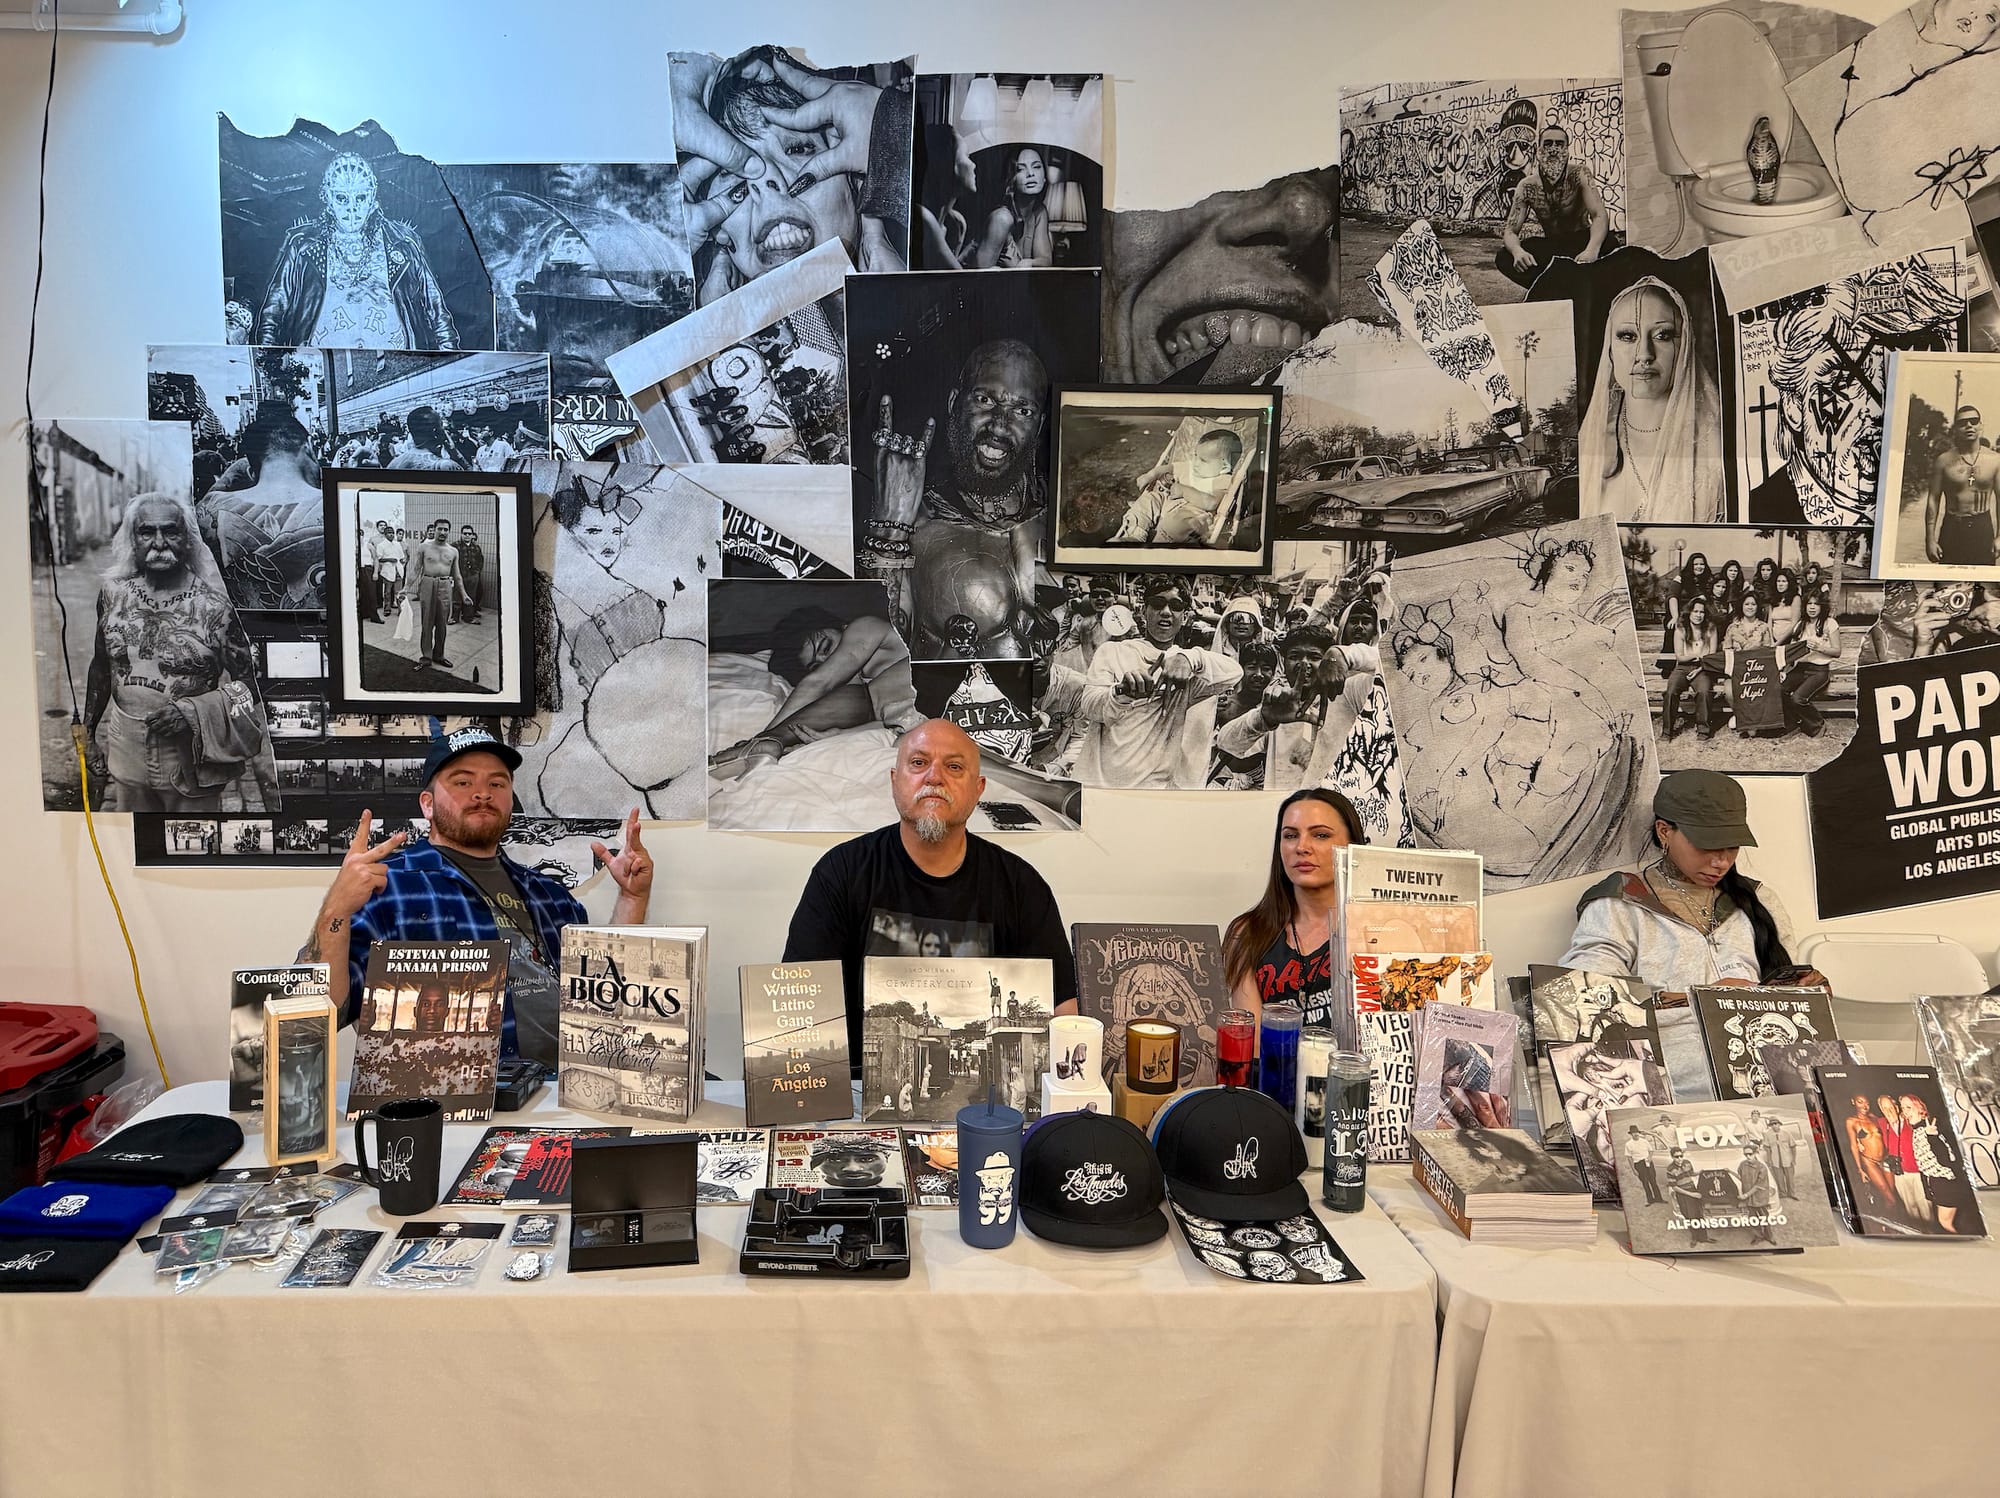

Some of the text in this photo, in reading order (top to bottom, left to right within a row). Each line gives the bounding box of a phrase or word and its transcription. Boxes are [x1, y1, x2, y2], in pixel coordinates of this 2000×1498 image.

[1890, 818, 1947, 840] GLOBAL
[1935, 833, 1974, 854] ARTS
[1385, 868, 1444, 887] TWENTY
[1905, 862, 1933, 880] LOS
[1371, 888, 1459, 902] TWENTYONE
[388, 948, 447, 960] ESTEVAN
[1090, 936, 1209, 977] YELAWOLF
[386, 961, 489, 972] PANAMA PRISON
[580, 955, 627, 983] L.A.
[771, 967, 812, 980] Cholo
[236, 969, 311, 988] Contagious
[885, 979, 973, 988] CEMETERY CITY
[283, 984, 327, 996] Culture
[570, 977, 681, 1017] BLOCKS
[762, 983, 822, 997] Writing:
[1716, 998, 1811, 1012] THE PASSION OF THE
[776, 1015, 814, 1029] Gang
[772, 1030, 821, 1045] Graffiti
[790, 1048, 804, 1059] in
[785, 1061, 811, 1075] Los
[772, 1076, 828, 1093] Angeles
[699, 1132, 765, 1142] APOZ
[777, 1132, 824, 1142] RAP
[907, 1133, 957, 1147] JUX
[1676, 1124, 1741, 1149] FOX
[776, 1158, 803, 1167] 13
[1418, 1147, 1455, 1198] FRESHEYES
[1423, 1170, 1459, 1220] FRESHEYES
[1667, 1215, 1788, 1230] ALFONSO OROZCO
[758, 1262, 784, 1270] BEYOND
